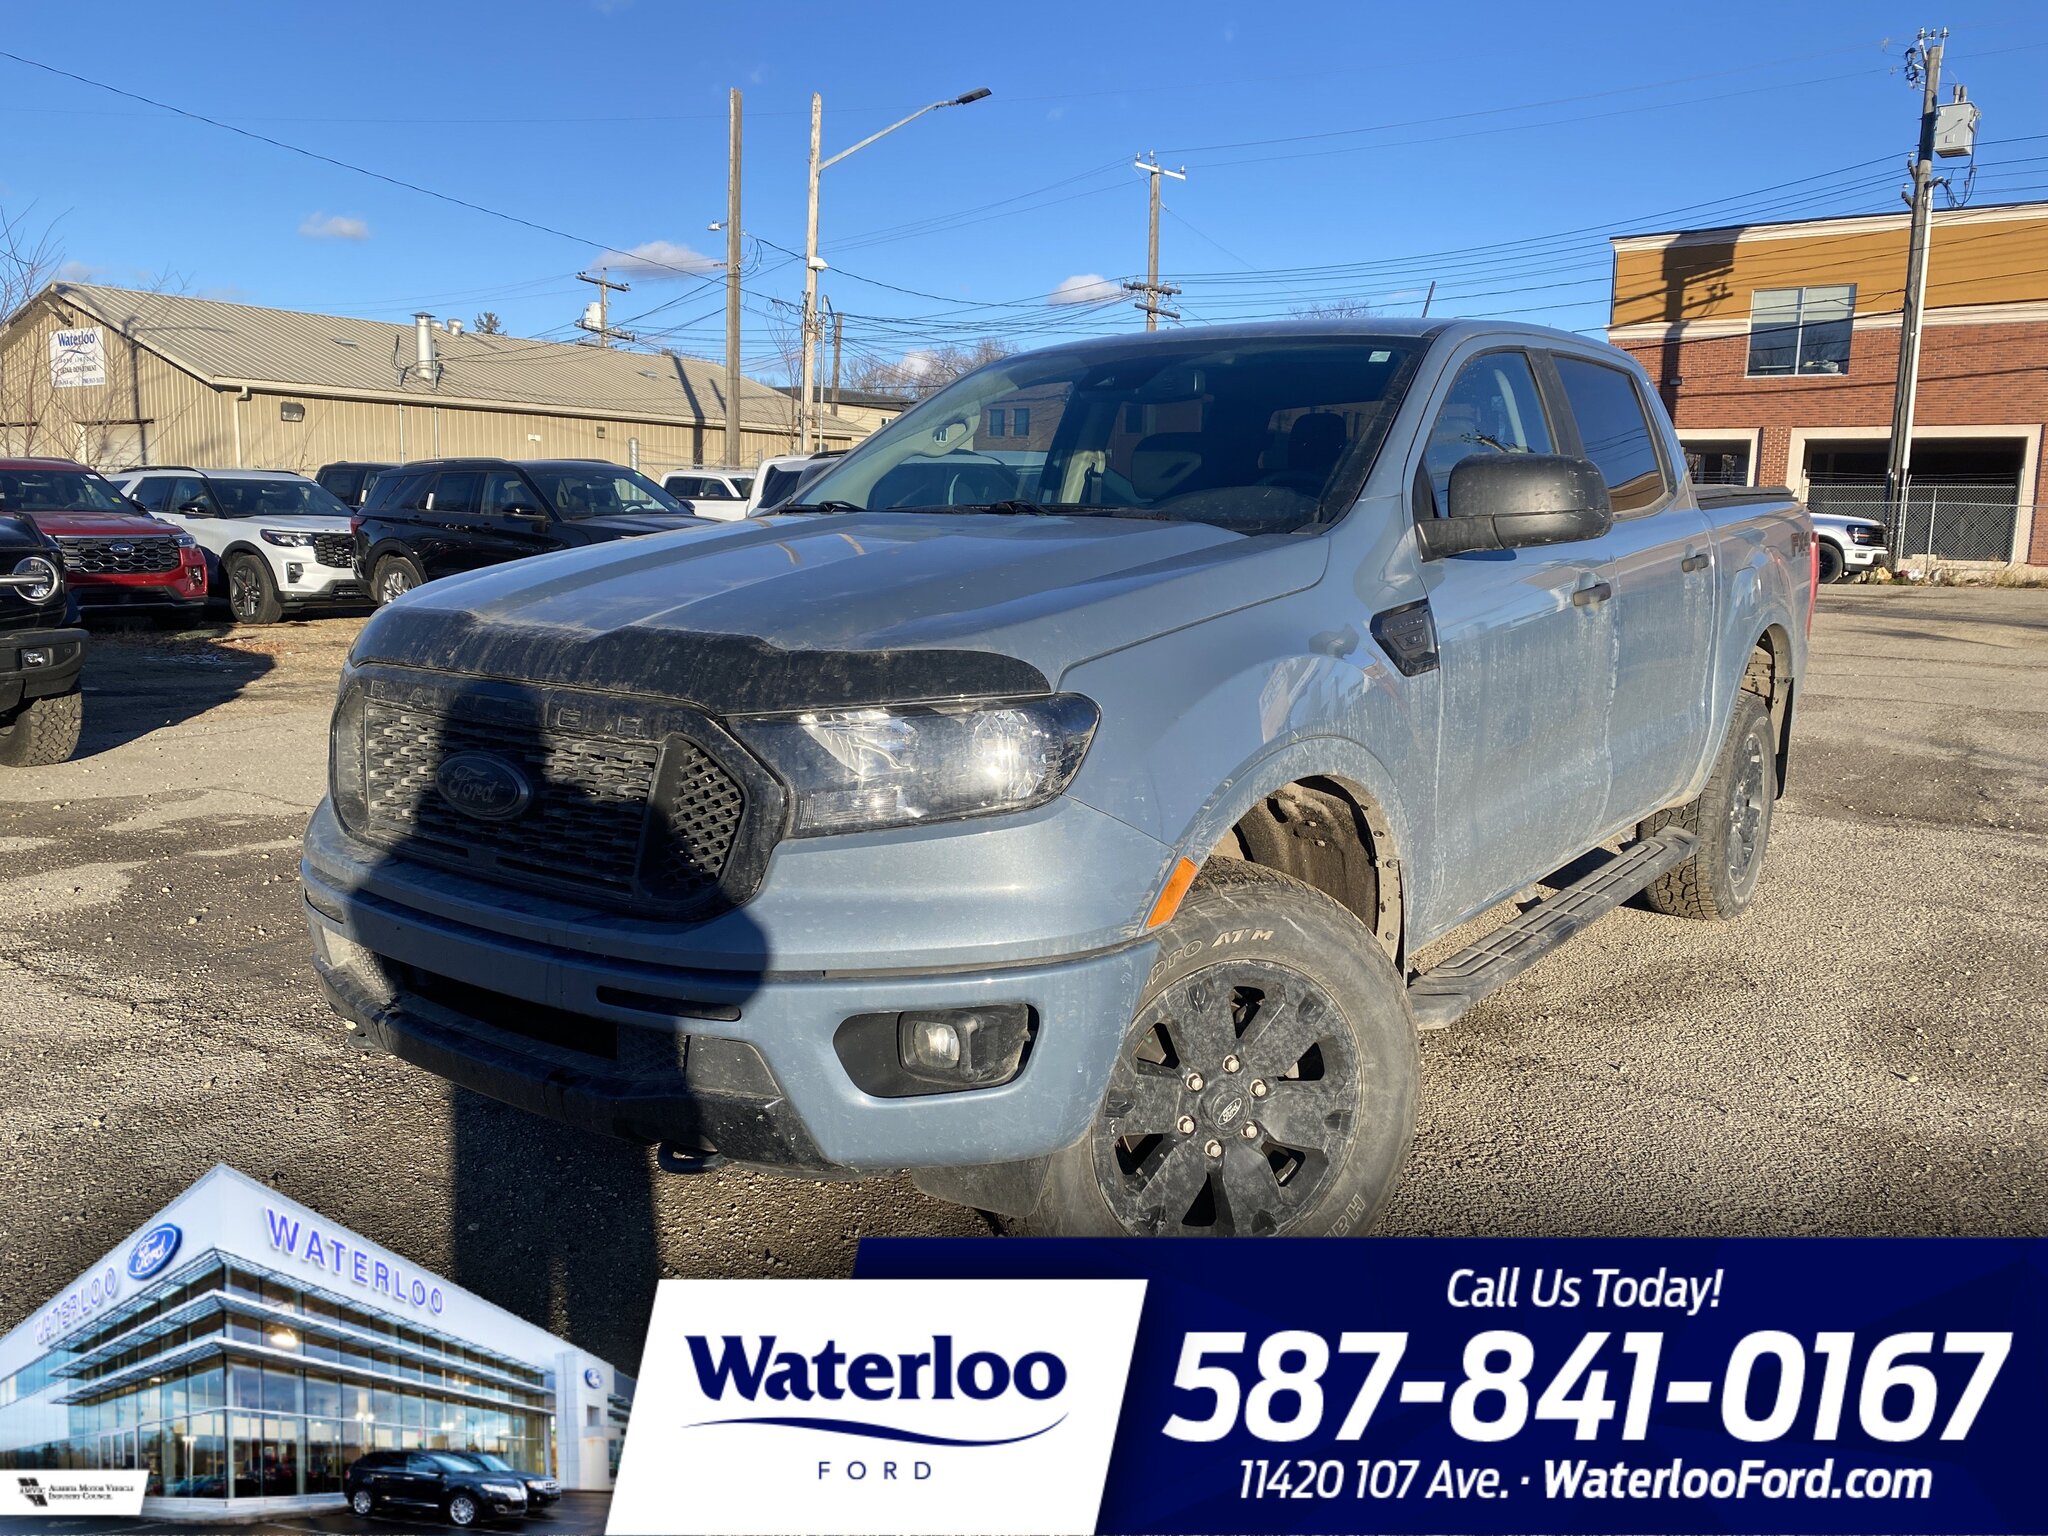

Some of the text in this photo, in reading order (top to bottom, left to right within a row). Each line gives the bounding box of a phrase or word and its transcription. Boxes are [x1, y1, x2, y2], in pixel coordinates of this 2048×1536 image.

[57, 331, 95, 346] Waterloo
[370, 680, 645, 738] RAER
[1147, 940, 1202, 986] pro
